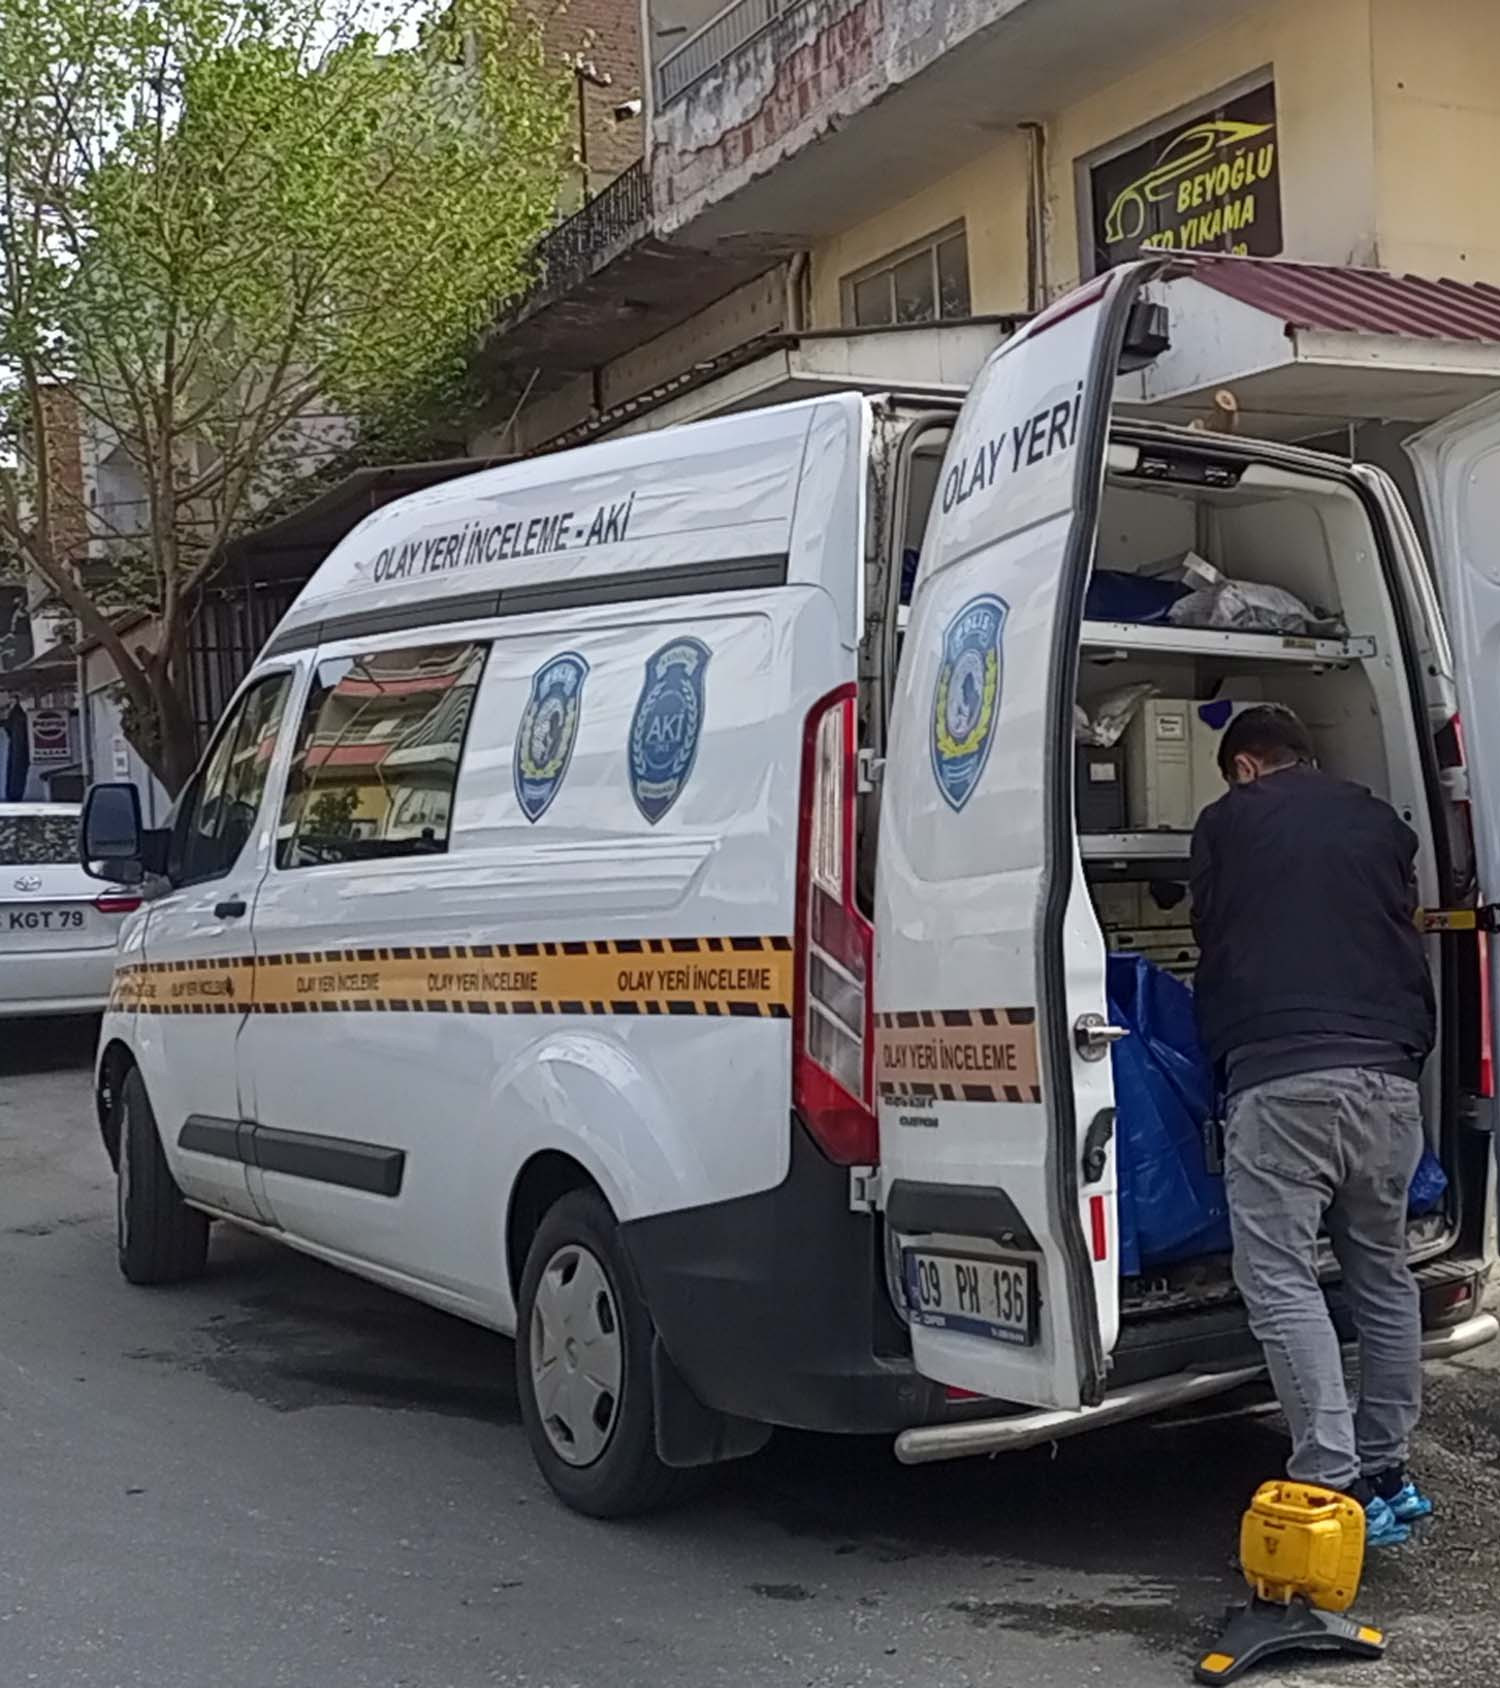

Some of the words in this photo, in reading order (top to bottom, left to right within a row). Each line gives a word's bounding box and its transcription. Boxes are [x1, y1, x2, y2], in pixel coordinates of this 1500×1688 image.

[1177, 144, 1274, 213] BEYOĞLU
[1180, 195, 1255, 249] YIKAMA
[943, 433, 1006, 514] OLAY
[1012, 380, 1083, 473] YERİ
[373, 541, 422, 583] OLAY
[421, 523, 469, 573] YERİ
[463, 513, 574, 564] İNCELEME
[585, 491, 635, 547] AKİ
[9, 912, 53, 930] KGT
[60, 911, 83, 929] 79
[617, 970, 655, 992] OLAY
[656, 965, 690, 991] YERİ
[692, 964, 770, 990] İNCELEME
[884, 1044, 908, 1069] OLAY
[910, 1038, 938, 1070] YERİ
[939, 1038, 1017, 1071] İNCELEME
[918, 1260, 941, 1307] 09
[993, 1270, 1024, 1323] 136
